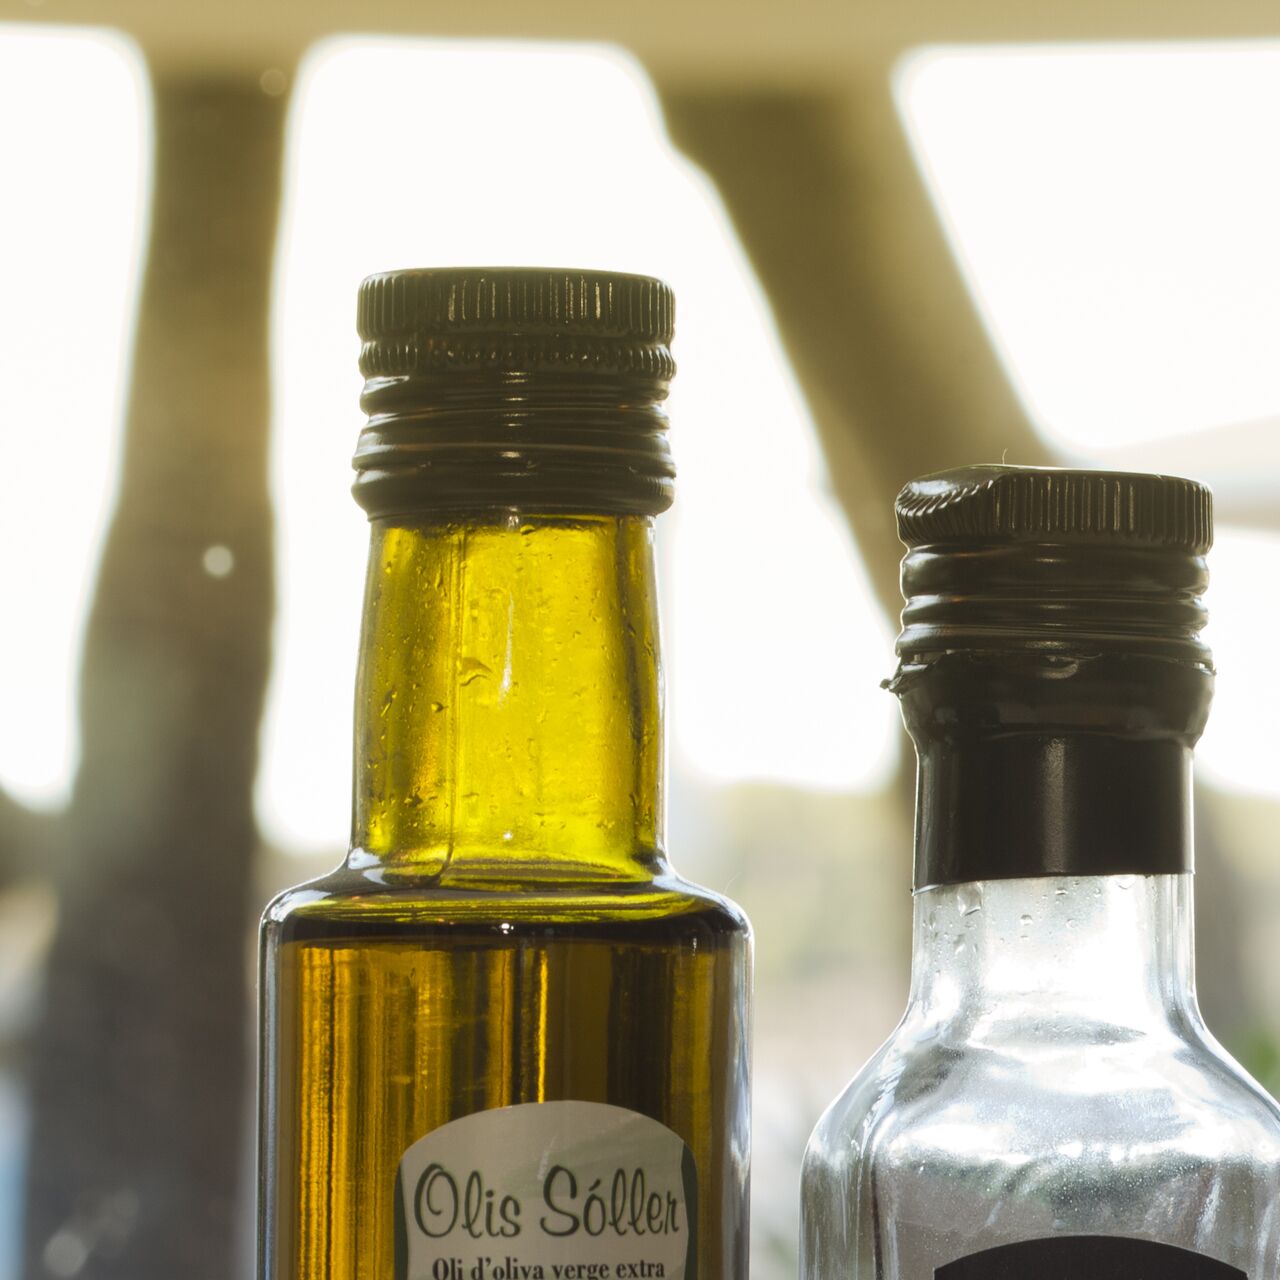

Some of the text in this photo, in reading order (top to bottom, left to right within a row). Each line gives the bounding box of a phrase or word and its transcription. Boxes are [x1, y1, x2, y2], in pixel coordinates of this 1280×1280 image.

[414, 1163, 681, 1238] Olis Sóller
[616, 1259, 665, 1280] extra
